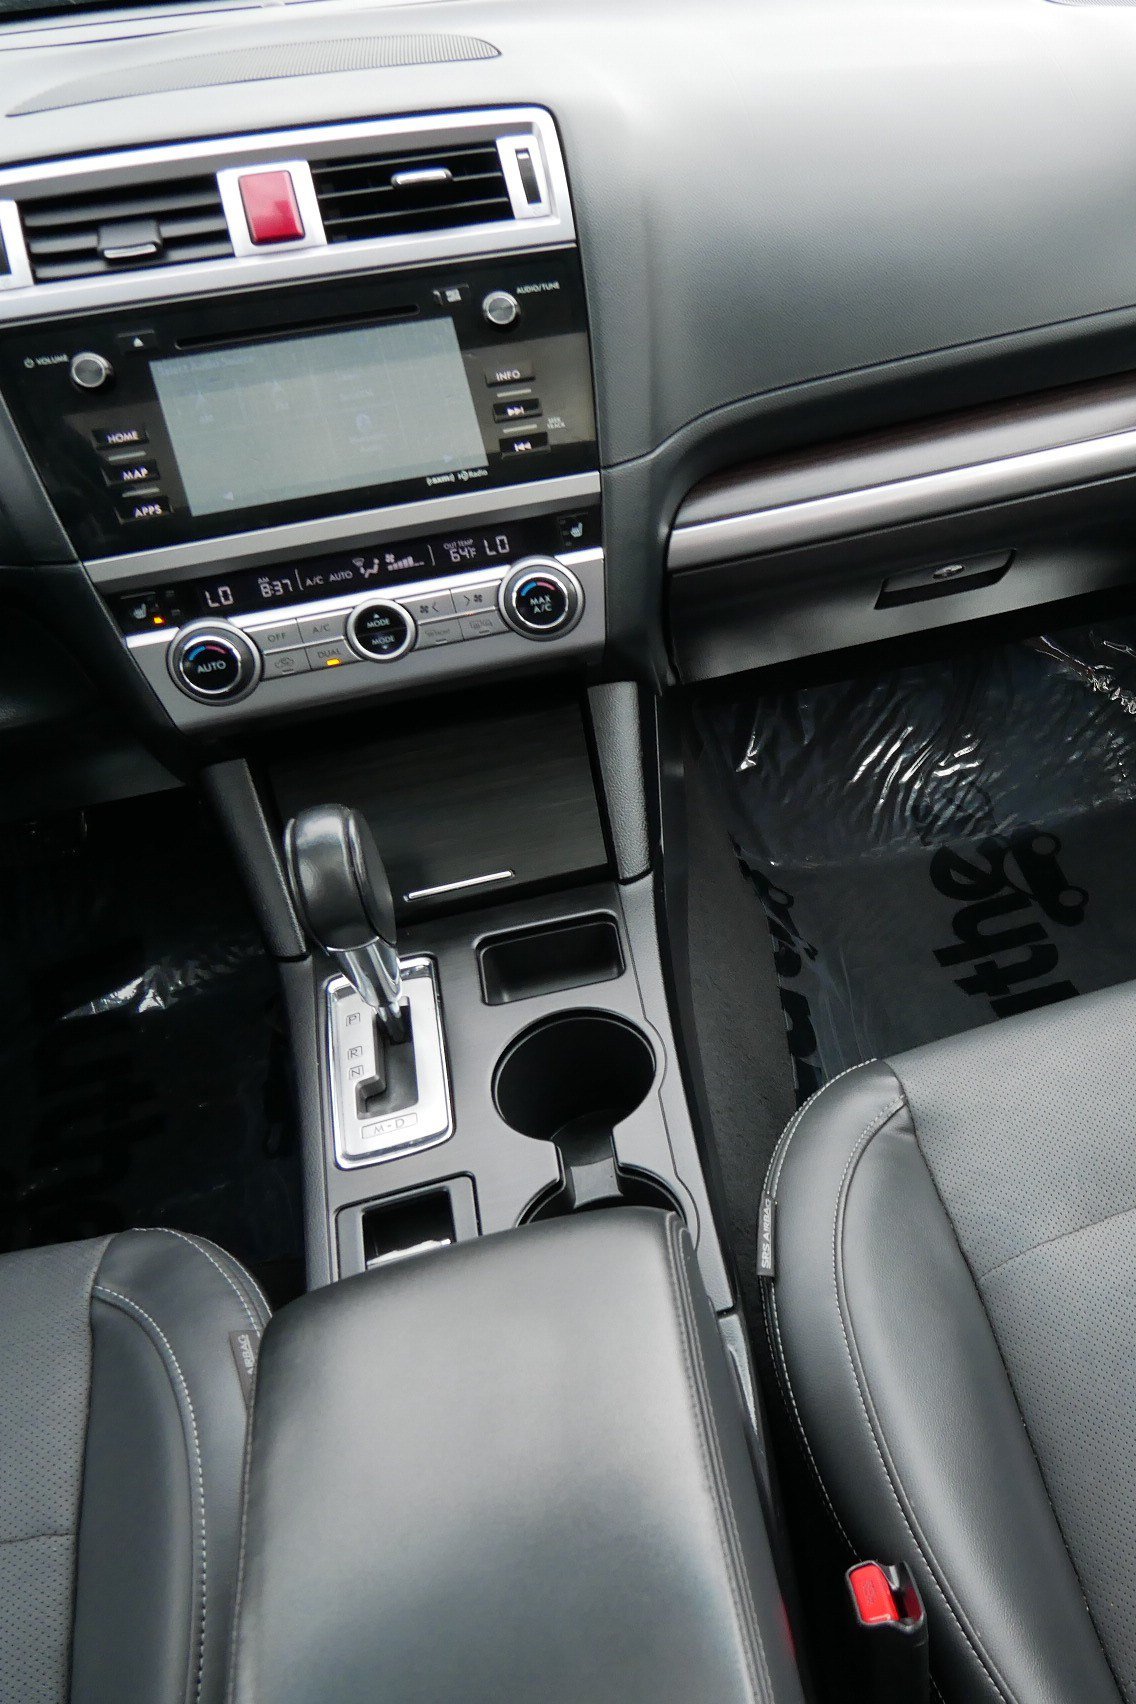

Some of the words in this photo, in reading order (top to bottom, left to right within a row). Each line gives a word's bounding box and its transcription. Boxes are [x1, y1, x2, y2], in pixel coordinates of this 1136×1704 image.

[516, 281, 560, 294] AUDIO/TUNE
[36, 354, 69, 366] VOLUME
[496, 369, 521, 381] INFO
[107, 430, 139, 444] HOME
[122, 466, 148, 481] MAP
[134, 503, 162, 518] APPS
[483, 535, 510, 556] LO
[205, 586, 234, 608] LO
[260, 578, 293, 598] 8:37
[306, 575, 325, 587] A/C
[329, 570, 353, 582] AUTO
[530, 594, 552, 606] MAX
[533, 603, 553, 614] A/C
[312, 623, 330, 634] A/C
[366, 617, 391, 629] MODE
[267, 632, 287, 643] OFF
[371, 634, 395, 646] MODE
[317, 647, 341, 659] DUAL
[197, 660, 227, 674] AUTO
[763, 1198, 772, 1241] AIRBAG
[761, 1243, 772, 1269] SRS
